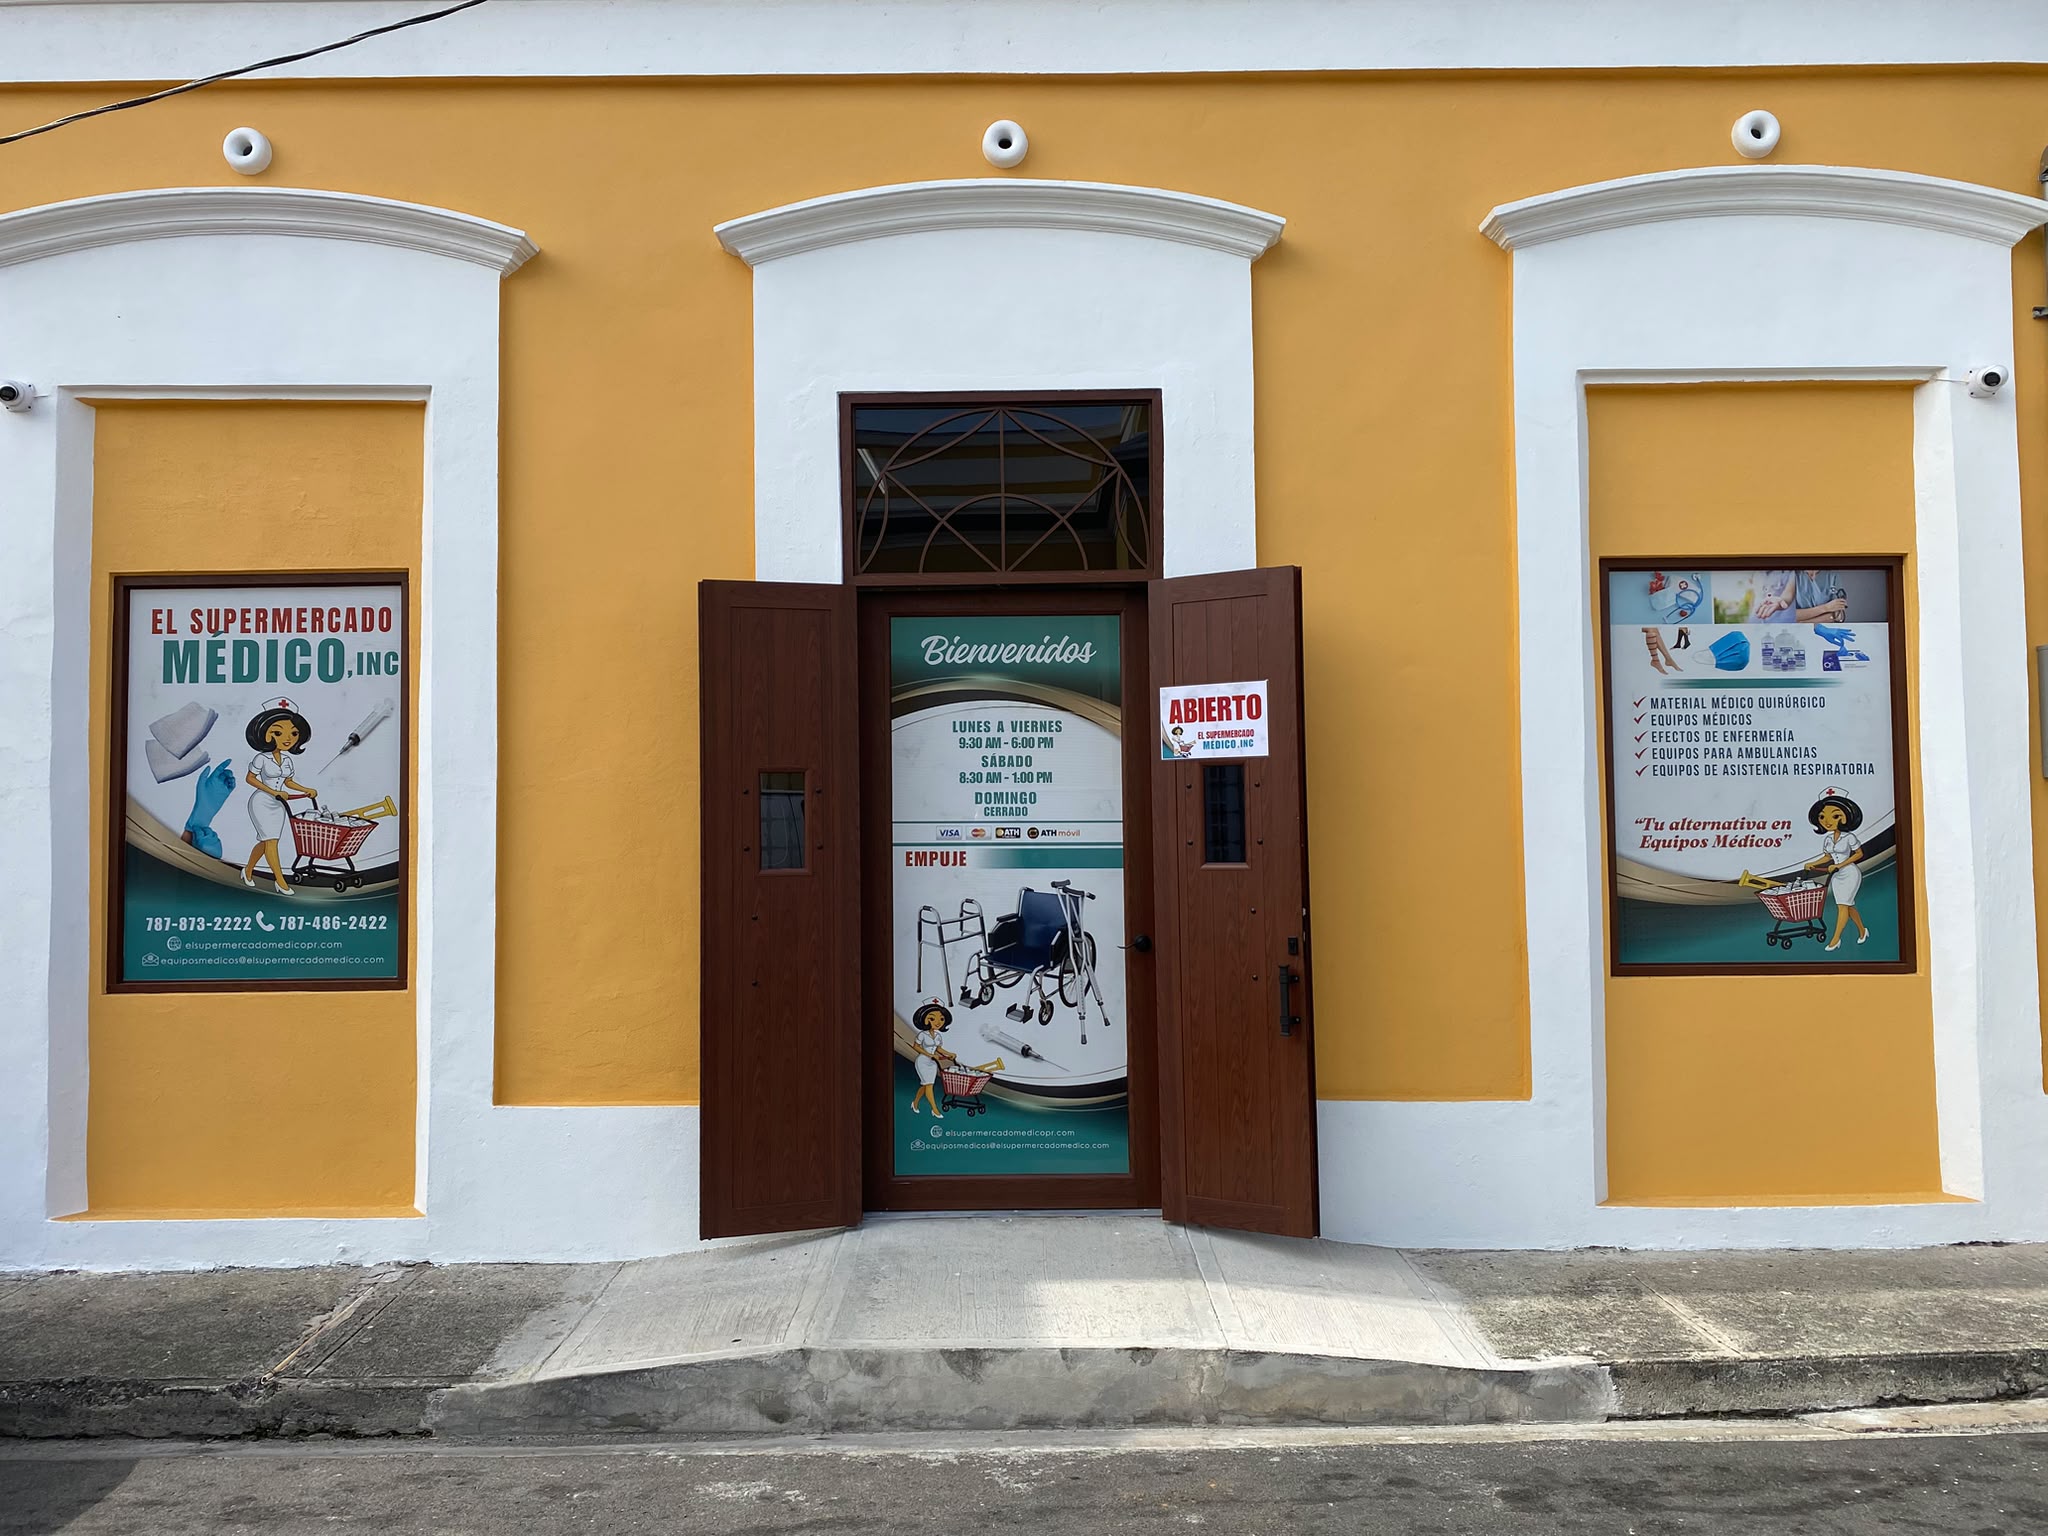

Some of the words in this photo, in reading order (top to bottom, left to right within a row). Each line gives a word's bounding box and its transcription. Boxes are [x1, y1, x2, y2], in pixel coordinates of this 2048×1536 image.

[152, 608, 178, 635] EL
[190, 606, 392, 635] SUPERMERCADO
[920, 634, 1097, 666] Bienvenidos
[1650, 697, 1707, 710] MATERIAL
[1711, 694, 1754, 709] MÉDICO
[1758, 693, 1826, 709] QUIRÚRGICO
[1169, 693, 1262, 725] ABIERTO
[1651, 713, 1698, 727] EQUIPOS
[1702, 711, 1752, 726] MÉDICOS
[952, 720, 991, 734] LUNES
[996, 720, 1005, 734] A
[1010, 720, 1063, 734] VIERNES
[1197, 731, 1205, 740] EL
[1206, 728, 1255, 740] SUPERMERCADO
[1651, 731, 1700, 744] EFECTOS
[1705, 730, 1719, 743] DE
[1723, 727, 1795, 743] ENFERMERÍA
[958, 737, 983, 750] 9:30
[985, 737, 1001, 749] AM
[1011, 737, 1035, 749] 6:00
[1037, 737, 1054, 749] PM
[1652, 747, 1699, 760] EQUIPOS
[1704, 747, 1733, 760] PARA
[1737, 746, 1818, 760] AMBULANCIAS
[980, 753, 1033, 768] SÁBADO
[1652, 764, 1700, 777] EQUIPOS
[1705, 764, 1718, 777] DE
[1722, 763, 1789, 777] ASISTENCIA
[1794, 762, 1875, 776] RESPIRATORIA
[959, 771, 983, 784] 8:30
[985, 771, 1001, 784] AM
[1011, 771, 1034, 784] 1:00
[1036, 771, 1053, 784] PM
[974, 791, 1037, 805] DOMINGO
[983, 806, 1028, 817] CERRADO
[1669, 817, 1769, 832] alternativa
[1773, 820, 1792, 831] en
[939, 829, 960, 837] VISA
[1003, 828, 1020, 837] ATH
[1040, 829, 1057, 837] ATH
[1058, 829, 1081, 837] móvil
[1640, 834, 1708, 852] Equipos
[905, 850, 967, 867] EMPUJE
[146, 916, 252, 932] 787-873-2222
[279, 915, 388, 930] 787-486-2422
[185, 939, 343, 951] elsupermercadomedicopr.com
[160, 954, 385, 966] equiposmedicos@elsupermercadomedico.com
[945, 1128, 1076, 1138] elsupermercadomedicopr.com
[925, 1140, 1110, 1151] equiposmedicos@elsupermercadomedico.com
